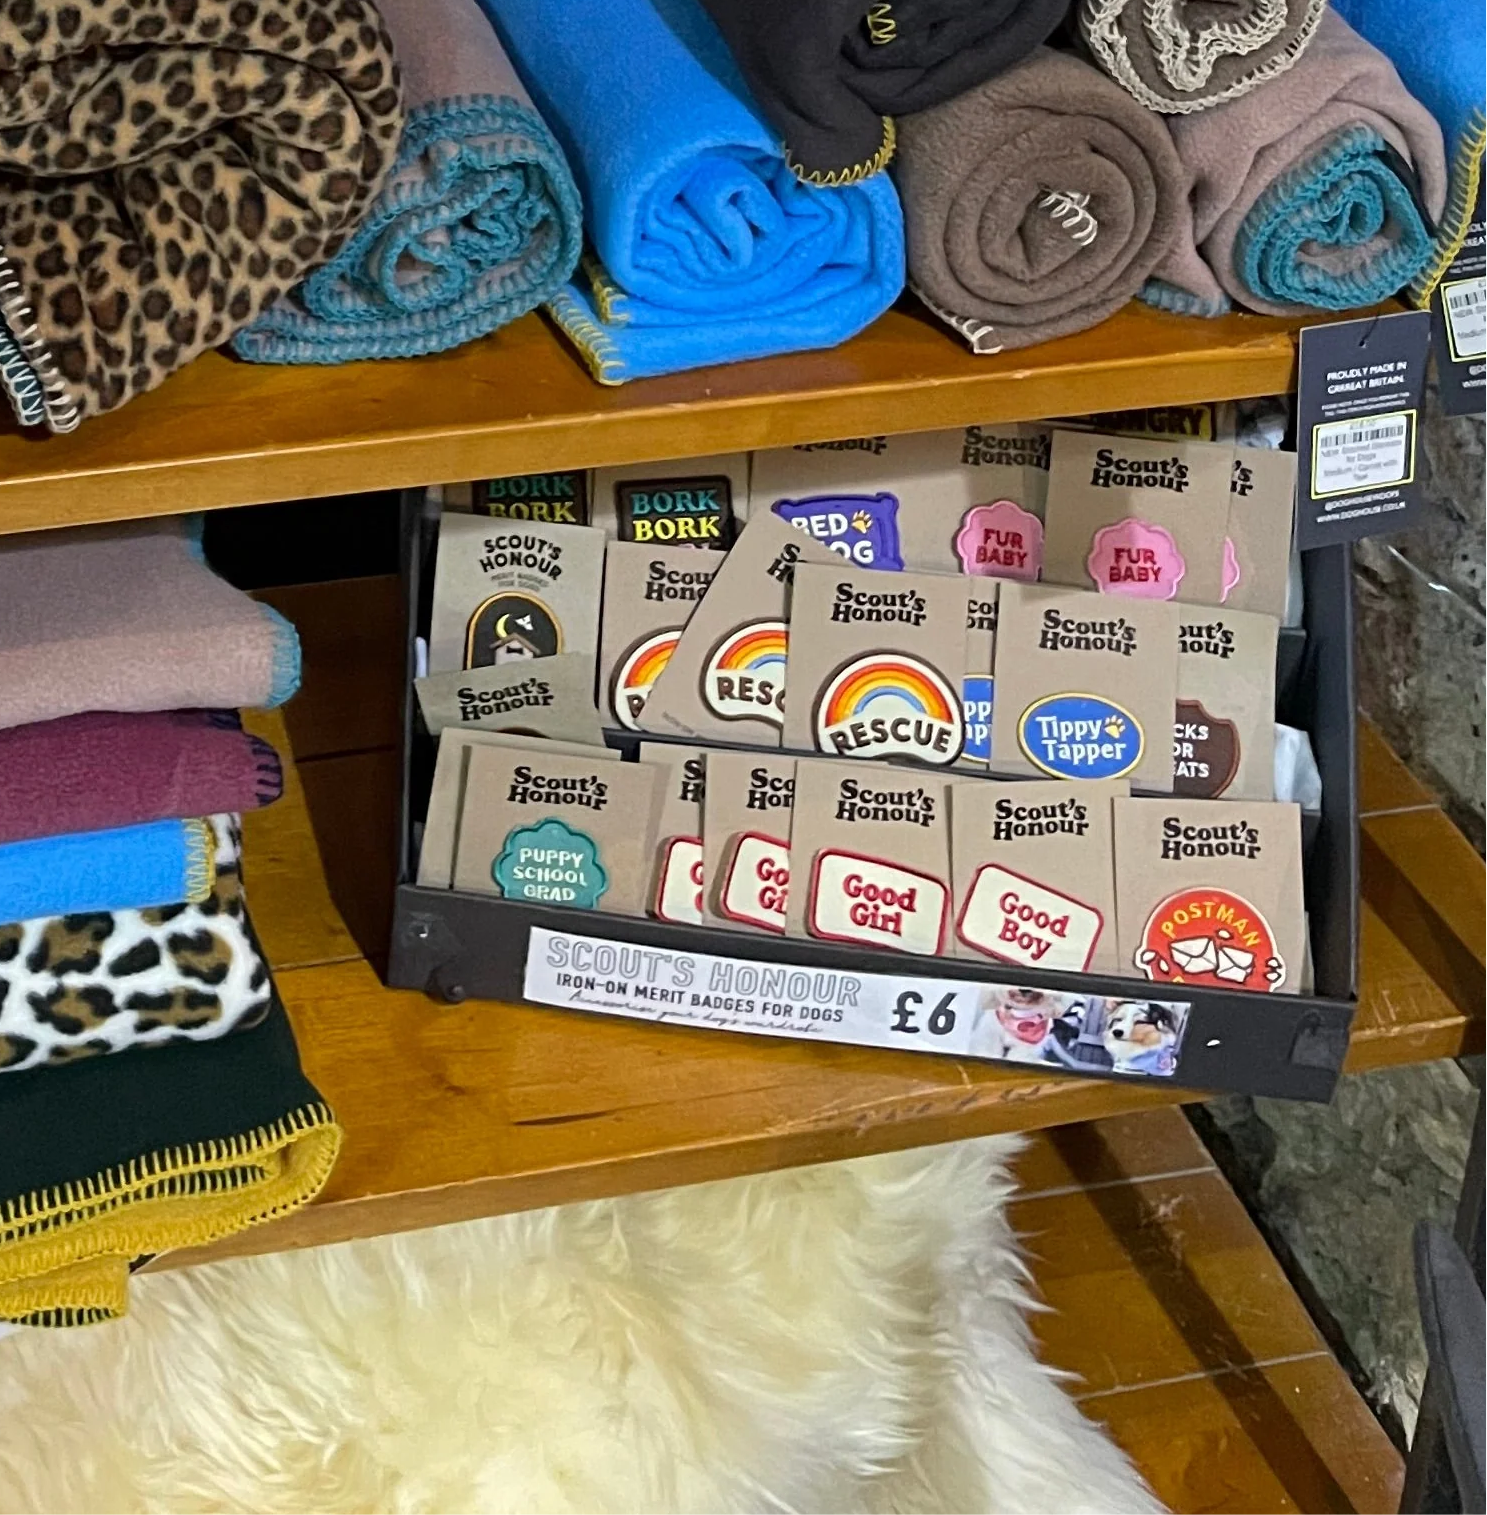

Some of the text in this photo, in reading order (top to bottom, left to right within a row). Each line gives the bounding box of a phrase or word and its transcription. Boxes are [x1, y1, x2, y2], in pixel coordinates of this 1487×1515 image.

[1370, 362, 1394, 376] MADE
[1397, 361, 1407, 371] IN
[1096, 448, 1189, 479] Scout's
[488, 475, 575, 499] BORK
[1090, 467, 1190, 493] Honour
[486, 501, 577, 523] BORK
[631, 489, 721, 515] BORK
[633, 516, 721, 541] BORK
[983, 528, 1024, 551] FUR
[484, 535, 562, 561] SCOUT'S
[975, 545, 1028, 569] BABY
[1113, 547, 1157, 566] FUR
[479, 551, 563, 581] HONOUR
[1108, 565, 1163, 584] BABY
[836, 582, 926, 612] Scout's
[831, 602, 927, 627] Honour
[1043, 608, 1137, 642] Scout's
[1039, 629, 1138, 657] Honour
[457, 677, 551, 705] Scout's
[459, 695, 555, 721] Honour
[829, 717, 953, 756] RESCUE
[1035, 716, 1103, 741] Tippy
[1041, 738, 1127, 765] Tapper
[514, 765, 608, 797] Scout's
[507, 784, 608, 811] Honour
[840, 779, 936, 812] Scout's
[835, 801, 936, 827] Honour
[995, 798, 1087, 821] Scout's
[993, 819, 1089, 841] Honour
[1163, 817, 1259, 844] Scout's
[519, 847, 585, 869] PUPPY
[1161, 839, 1261, 861] Honour
[512, 865, 588, 887] SCHOOL
[523, 884, 576, 902] GRAD
[842, 873, 918, 913] Good
[849, 903, 902, 937] Girl
[999, 891, 1070, 939] Good
[1160, 900, 1261, 947] POSTMAN
[998, 918, 1052, 961] Boy
[546, 936, 862, 1008] SCOUT'S HONOUR
[556, 972, 845, 1024] IRON-ON MERIT BADGES FOR DOGS
[889, 991, 959, 1036] £6
